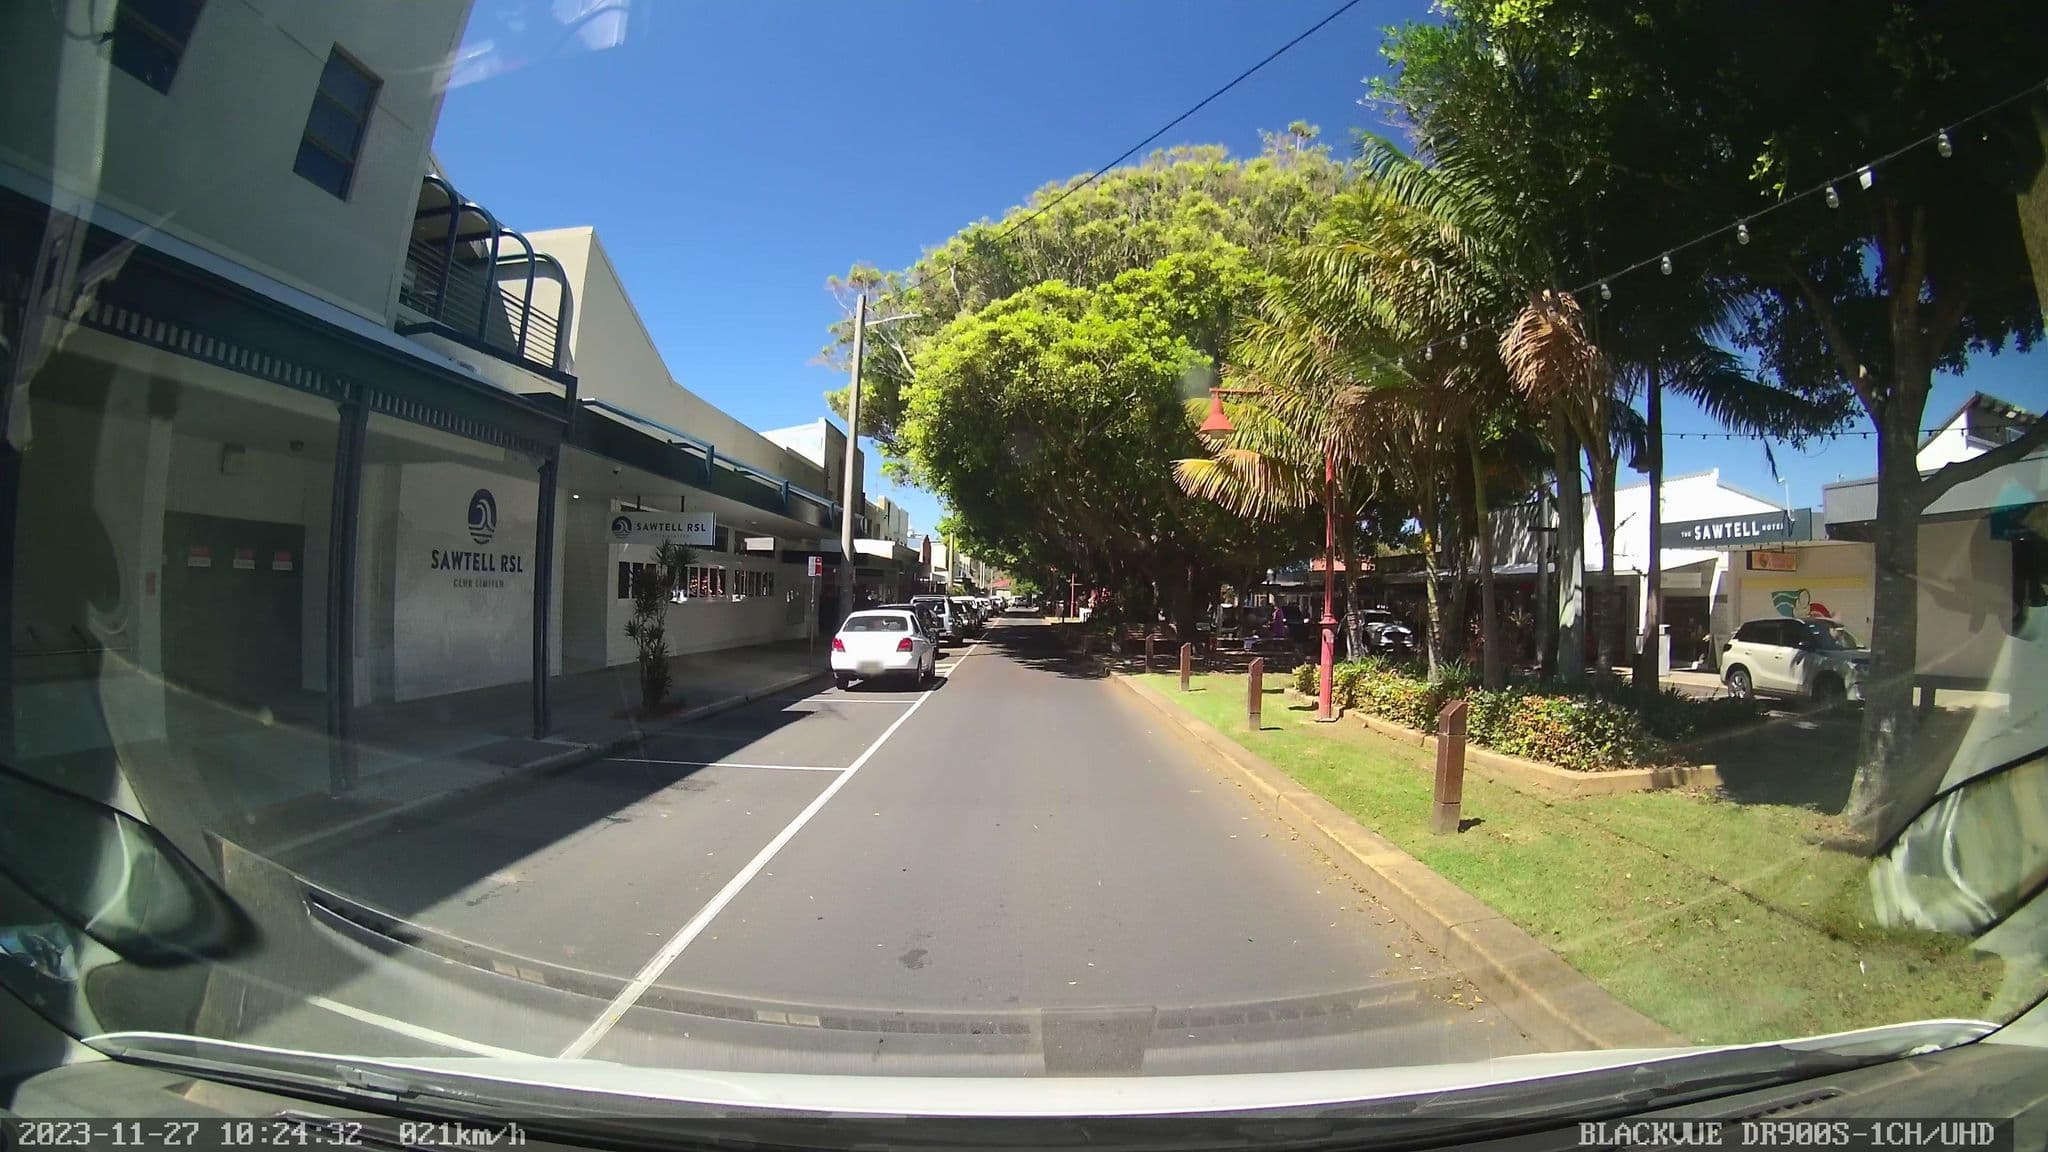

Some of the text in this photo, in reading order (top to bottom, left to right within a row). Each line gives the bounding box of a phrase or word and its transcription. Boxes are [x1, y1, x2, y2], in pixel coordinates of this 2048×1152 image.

[637, 522, 706, 532] SAWTELL RSL
[1694, 520, 1760, 541] SAWTELL
[431, 549, 523, 573] SAWTELL RSL
